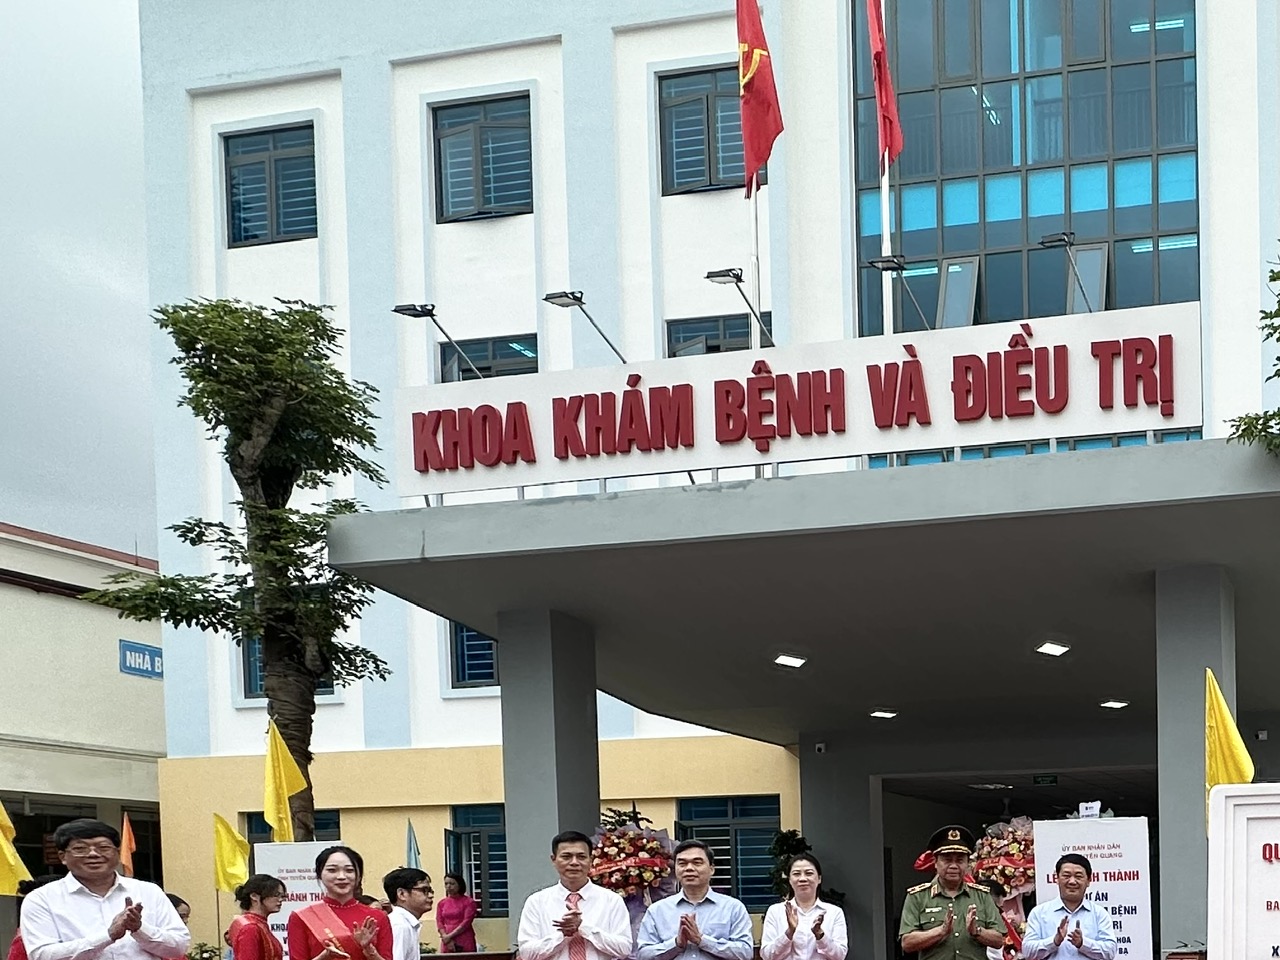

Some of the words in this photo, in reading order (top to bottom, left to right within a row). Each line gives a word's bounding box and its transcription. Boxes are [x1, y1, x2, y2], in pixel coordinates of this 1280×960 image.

[412, 402, 536, 473] KHOA
[552, 374, 695, 460] KHÁM
[714, 360, 846, 453] BỆNH
[866, 344, 931, 428] VÀ
[951, 323, 1068, 424] ĐIỀU
[1091, 334, 1175, 418] TRỊ
[126, 651, 152, 671] NHÀ
[1103, 868, 1140, 882] THÀNH
[1095, 891, 1108, 901] ÁN
[1111, 904, 1137, 917] BỆNH
[1113, 921, 1123, 932] RỊ
